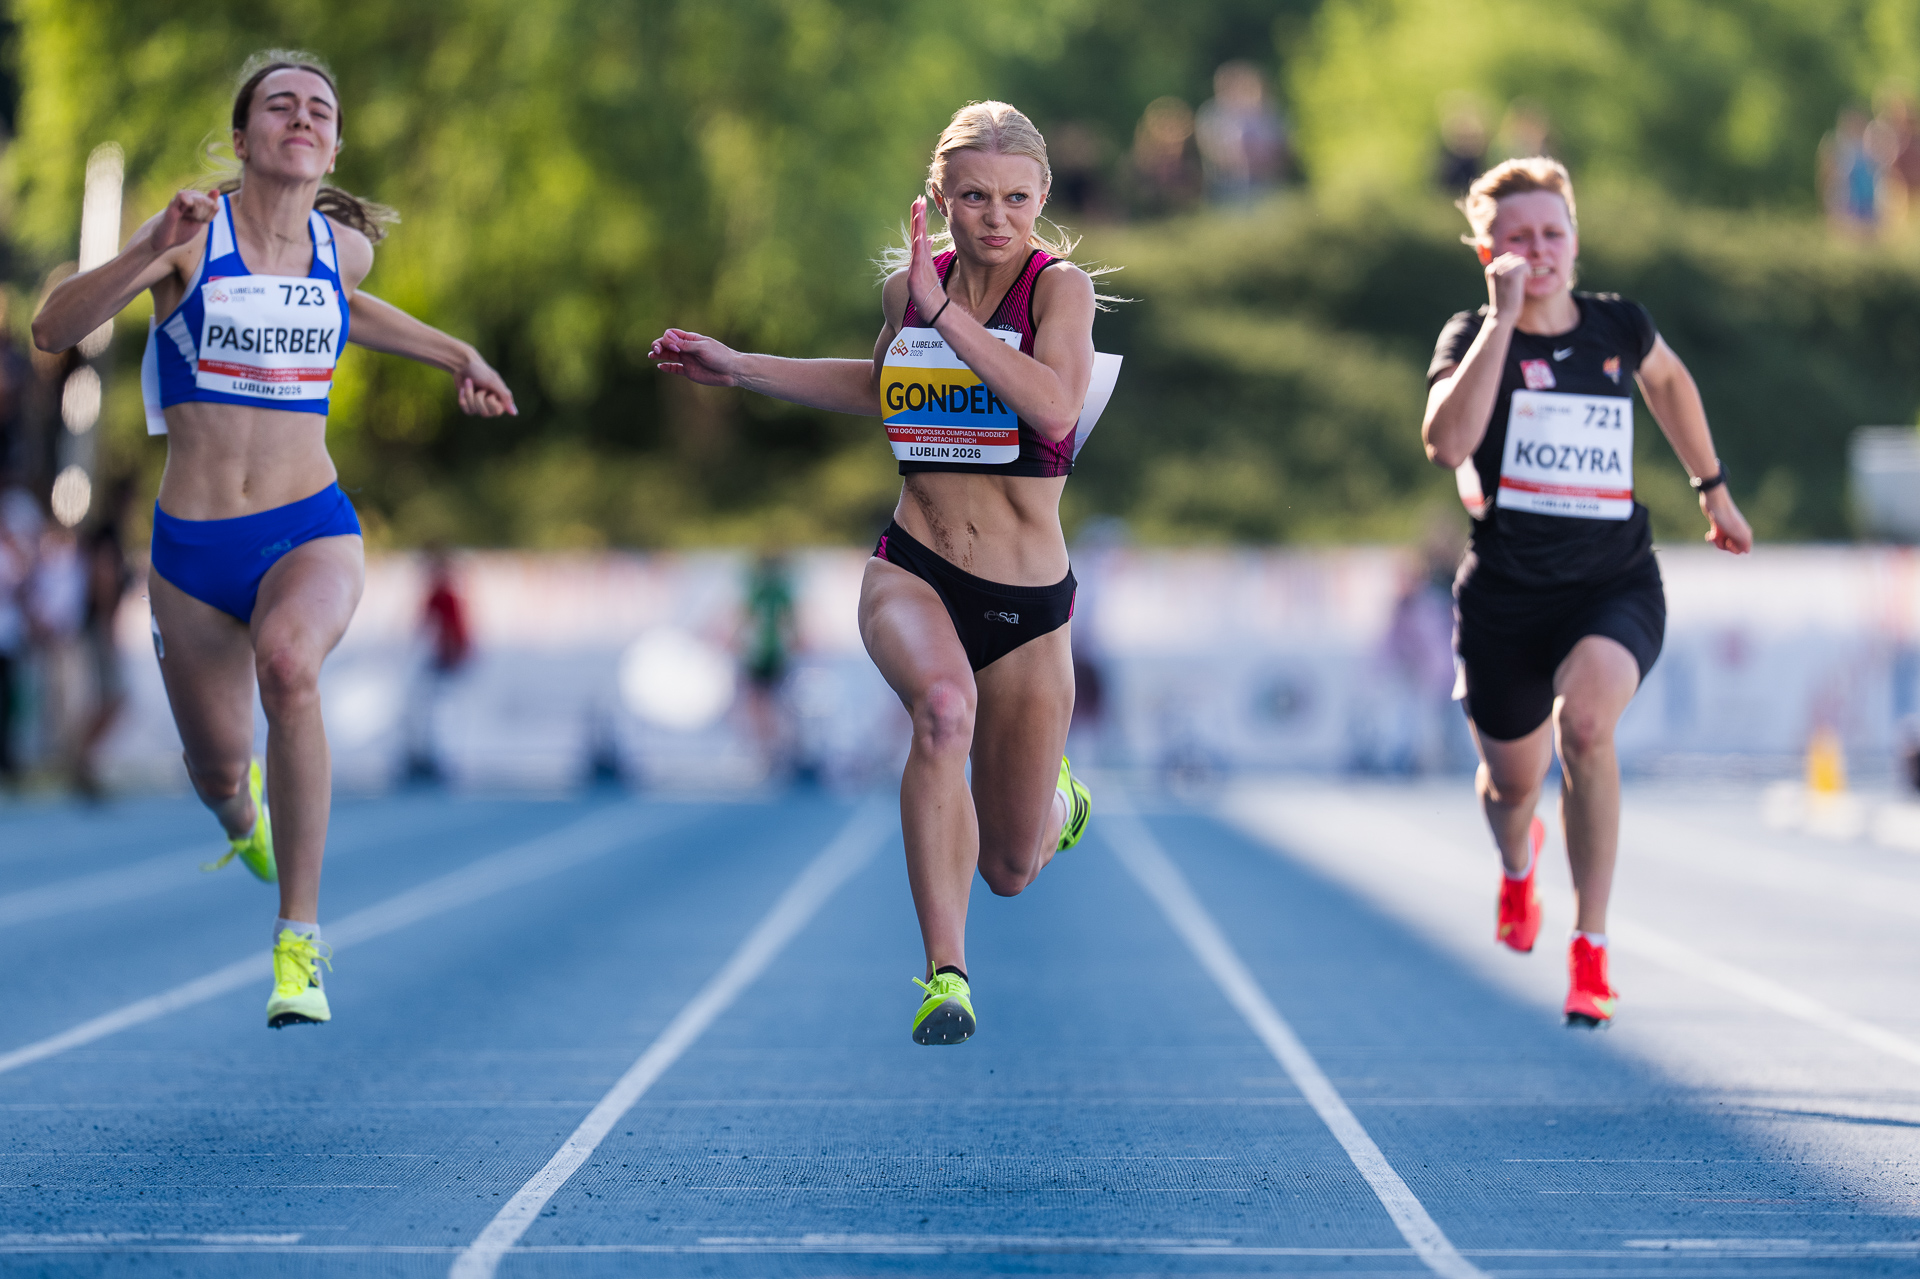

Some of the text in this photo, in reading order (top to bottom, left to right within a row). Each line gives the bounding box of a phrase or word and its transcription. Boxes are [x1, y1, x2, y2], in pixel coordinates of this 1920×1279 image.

[279, 285, 325, 306] 723
[207, 325, 334, 353] PASIERBEK
[911, 340, 944, 349] LUBELSKIE
[232, 381, 302, 396] LUBLIN 2026
[1584, 404, 1622, 429] 721
[900, 427, 945, 435] OGÓLNOPOLSKA
[910, 446, 981, 458] LUBLIN 2026
[1515, 441, 1621, 473] KOZYRA
